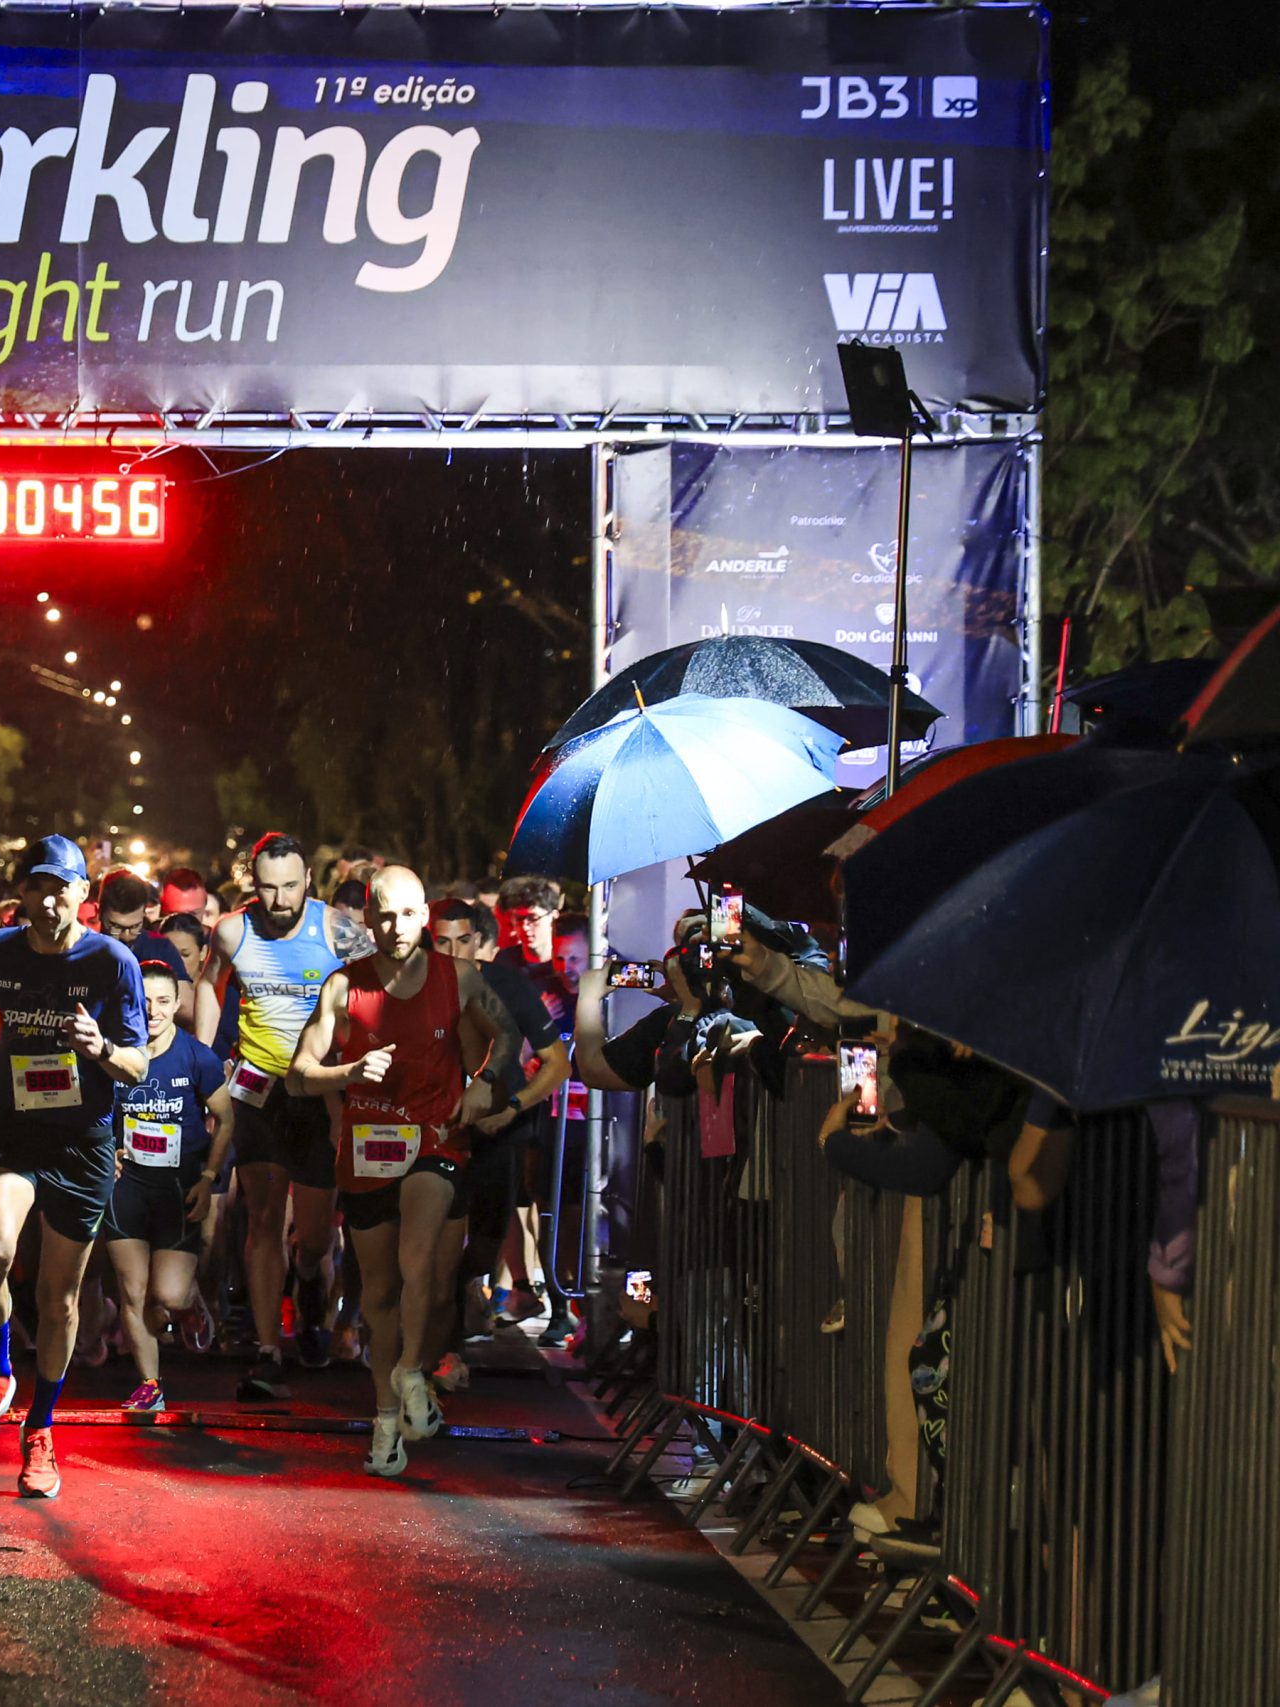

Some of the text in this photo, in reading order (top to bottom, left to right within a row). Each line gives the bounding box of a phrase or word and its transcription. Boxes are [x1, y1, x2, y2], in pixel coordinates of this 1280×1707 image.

[373, 76, 476, 110] edição
[801, 76, 909, 119] JB3
[823, 158, 954, 220] LIVE!
[138, 278, 284, 343] run
[705, 559, 788, 573] ANDERLE
[852, 572, 923, 585] Cardiogic
[835, 629, 938, 643] DON GIOANNI
[67, 986, 89, 997] LIVE!
[171, 1077, 190, 1088] LIVE!
